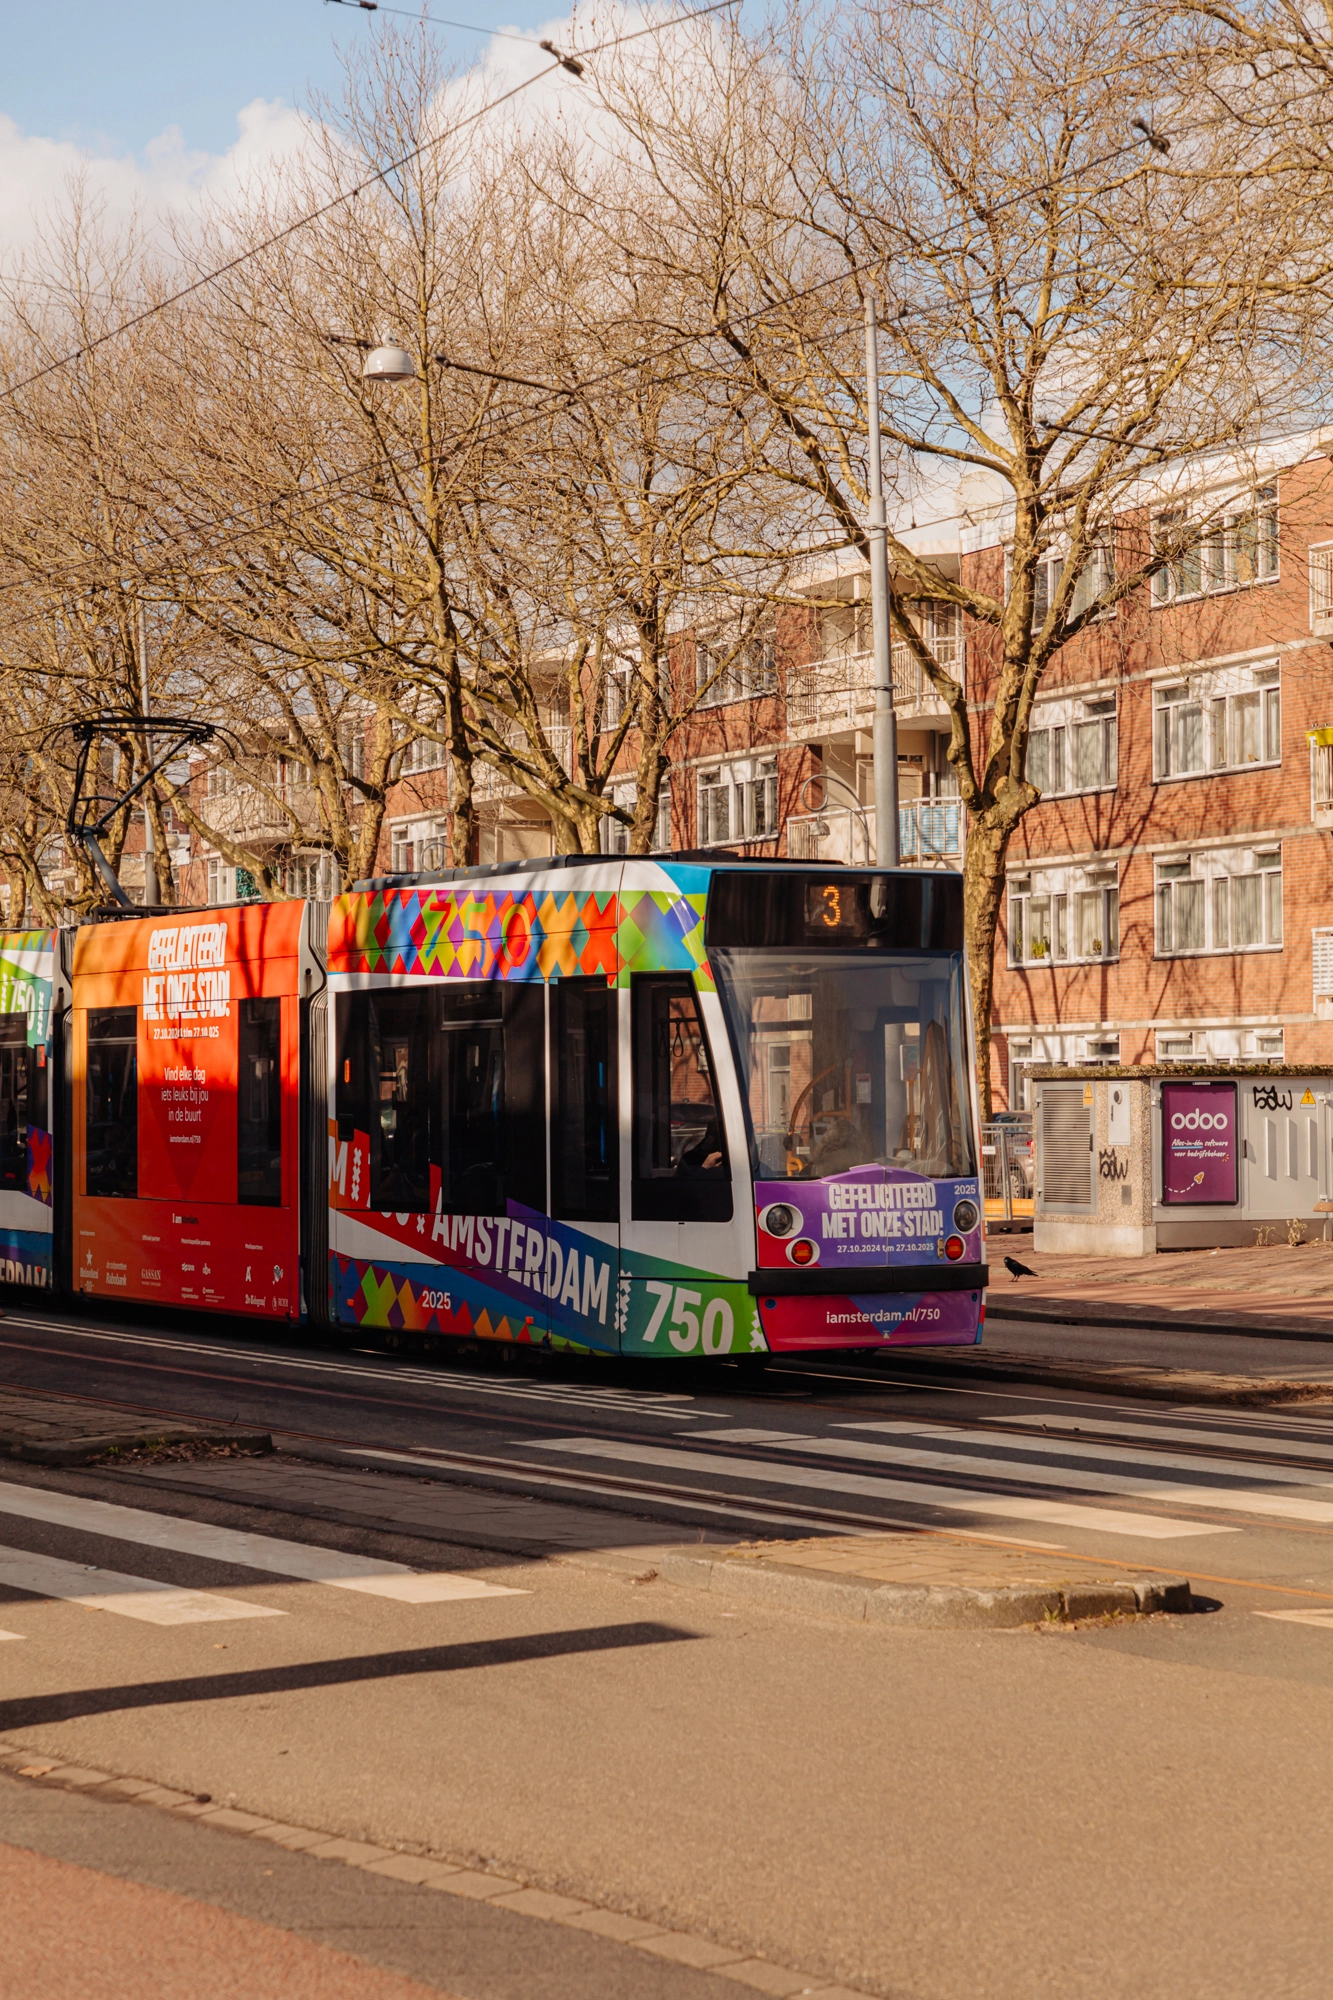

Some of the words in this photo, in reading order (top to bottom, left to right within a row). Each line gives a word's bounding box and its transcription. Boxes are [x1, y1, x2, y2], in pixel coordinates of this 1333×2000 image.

[823, 886, 840, 926] 3
[148, 923, 228, 973] GEFELICITEERD
[143, 975, 165, 1021] MET
[166, 973, 198, 1020] ONZE
[197, 970, 230, 1018] STAD!
[164, 1067, 179, 1081] Vind
[179, 1066, 192, 1081] elke
[193, 1066, 206, 1084] dag
[161, 1088, 172, 1102] iets
[173, 1087, 188, 1102] leuks
[190, 1086, 198, 1104] bij
[198, 1088, 209, 1104] jou
[168, 1108, 174, 1122] in
[175, 1107, 184, 1122] de
[184, 1106, 201, 1122] buurt
[1171, 1108, 1228, 1130] odoo
[1204, 1139, 1228, 1147] software
[829, 1183, 937, 1210] GEFELICITEERD
[954, 1185, 976, 1195] 2025
[822, 1212, 857, 1239] MET
[860, 1211, 901, 1238] ONZE
[903, 1210, 944, 1237] STAD!
[431, 1186, 610, 1326] AMSTERDAM
[837, 1244, 881, 1253] 27.10.2024
[896, 1243, 934, 1251] 27.10.2025
[422, 1291, 451, 1310] 2025
[642, 1280, 734, 1356] 750
[826, 1308, 941, 1323] iamsterdam.nl/750
